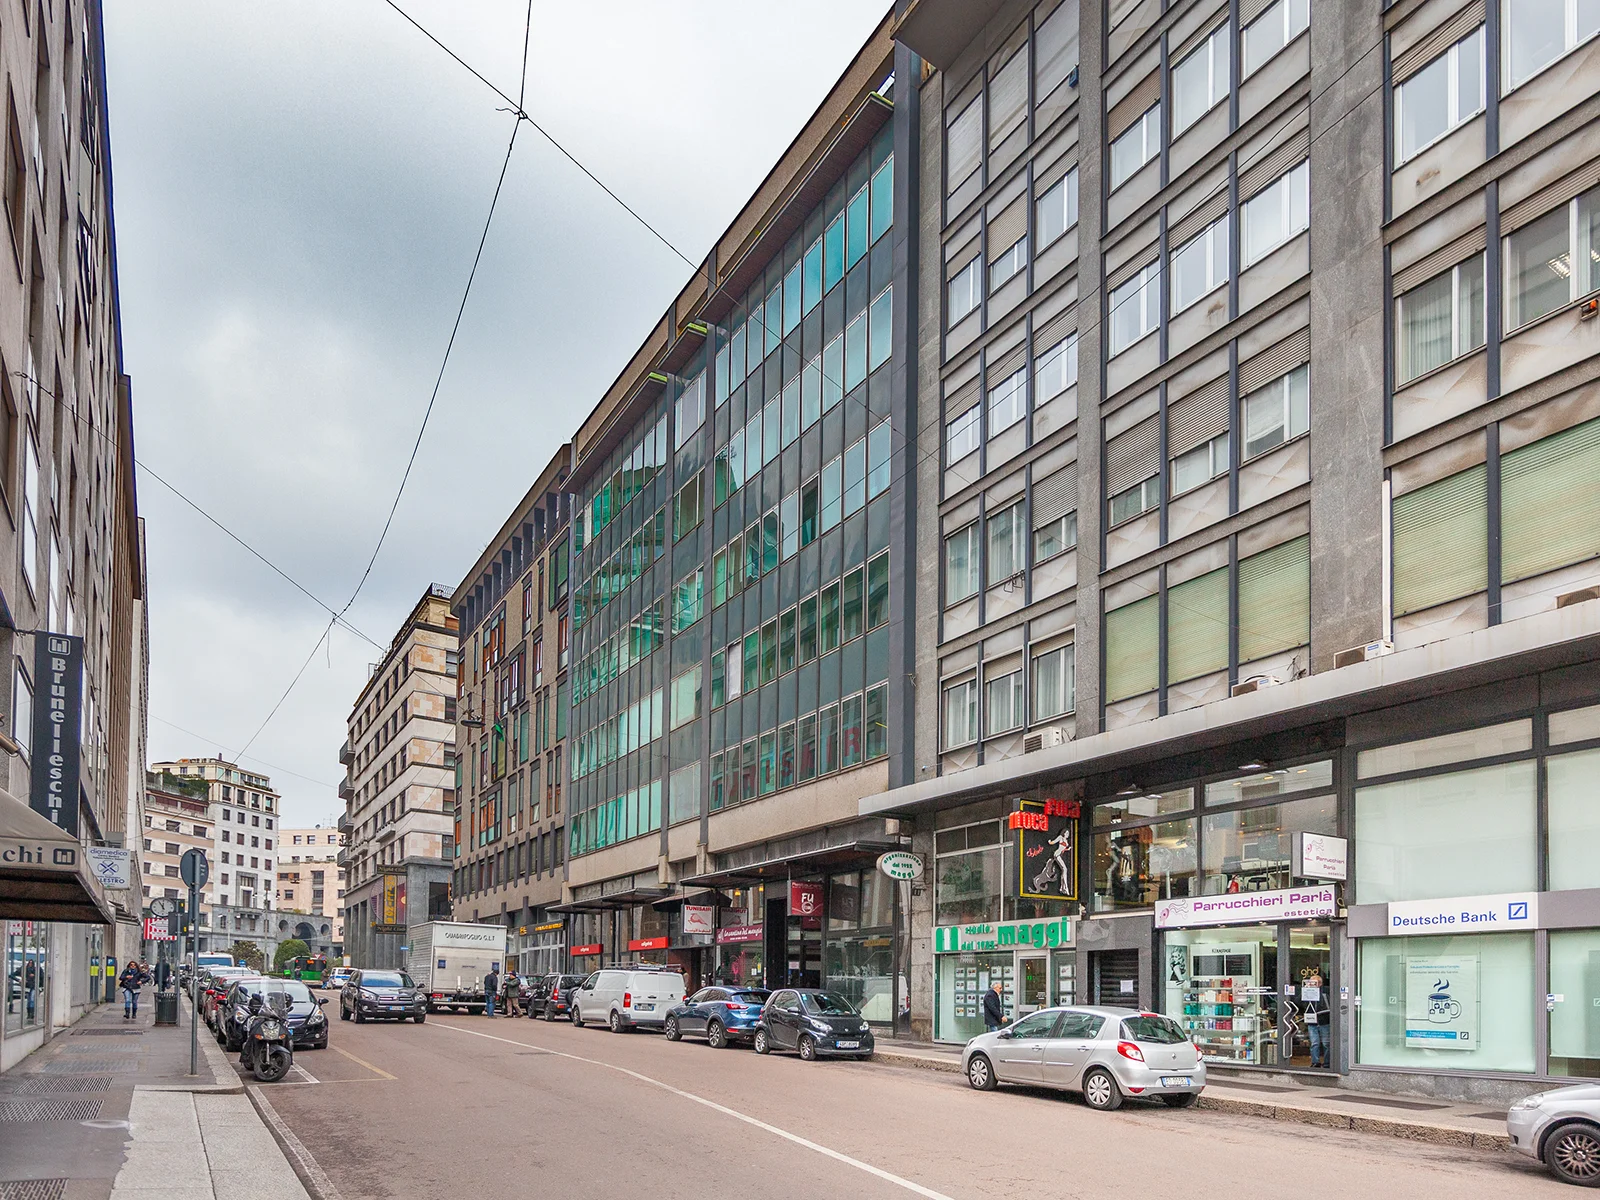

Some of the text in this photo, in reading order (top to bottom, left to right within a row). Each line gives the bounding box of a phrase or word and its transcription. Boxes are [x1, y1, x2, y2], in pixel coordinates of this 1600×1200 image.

[48, 657, 66, 823] Brunelleschi
[2, 845, 44, 864] chi
[90, 848, 128, 857] diamedica
[890, 870, 915, 878] maggi
[1193, 889, 1333, 912] Parrucchieri Parlà
[1284, 907, 1333, 917] estetica
[1392, 911, 1497, 927] Deutsche Bank
[965, 924, 991, 935] studio
[997, 916, 1069, 949] maggi
[961, 941, 974, 951] dal
[1300, 966, 1319, 979] ghd
